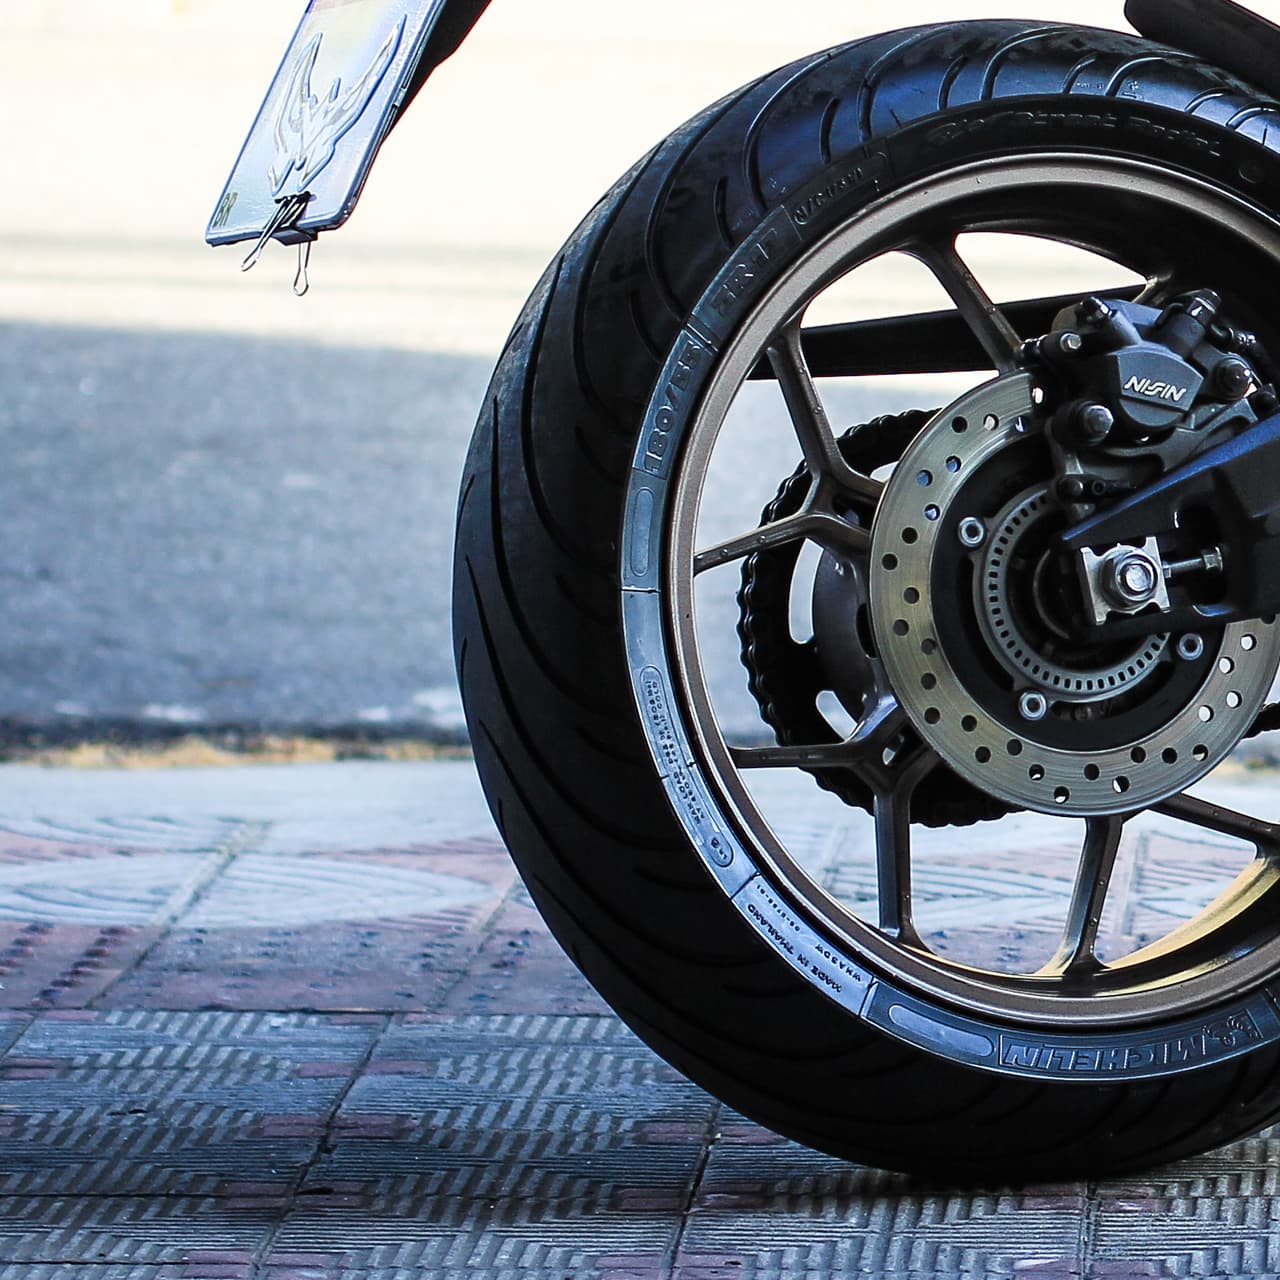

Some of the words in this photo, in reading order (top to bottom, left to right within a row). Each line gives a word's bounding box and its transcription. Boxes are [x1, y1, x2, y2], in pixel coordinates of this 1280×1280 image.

[640, 339, 705, 473] 180/55
[745, 901, 796, 956] THAILAND
[795, 952, 810, 968] IN
[809, 964, 843, 993] MADE
[1003, 1032, 1207, 1072] MICHELIN
